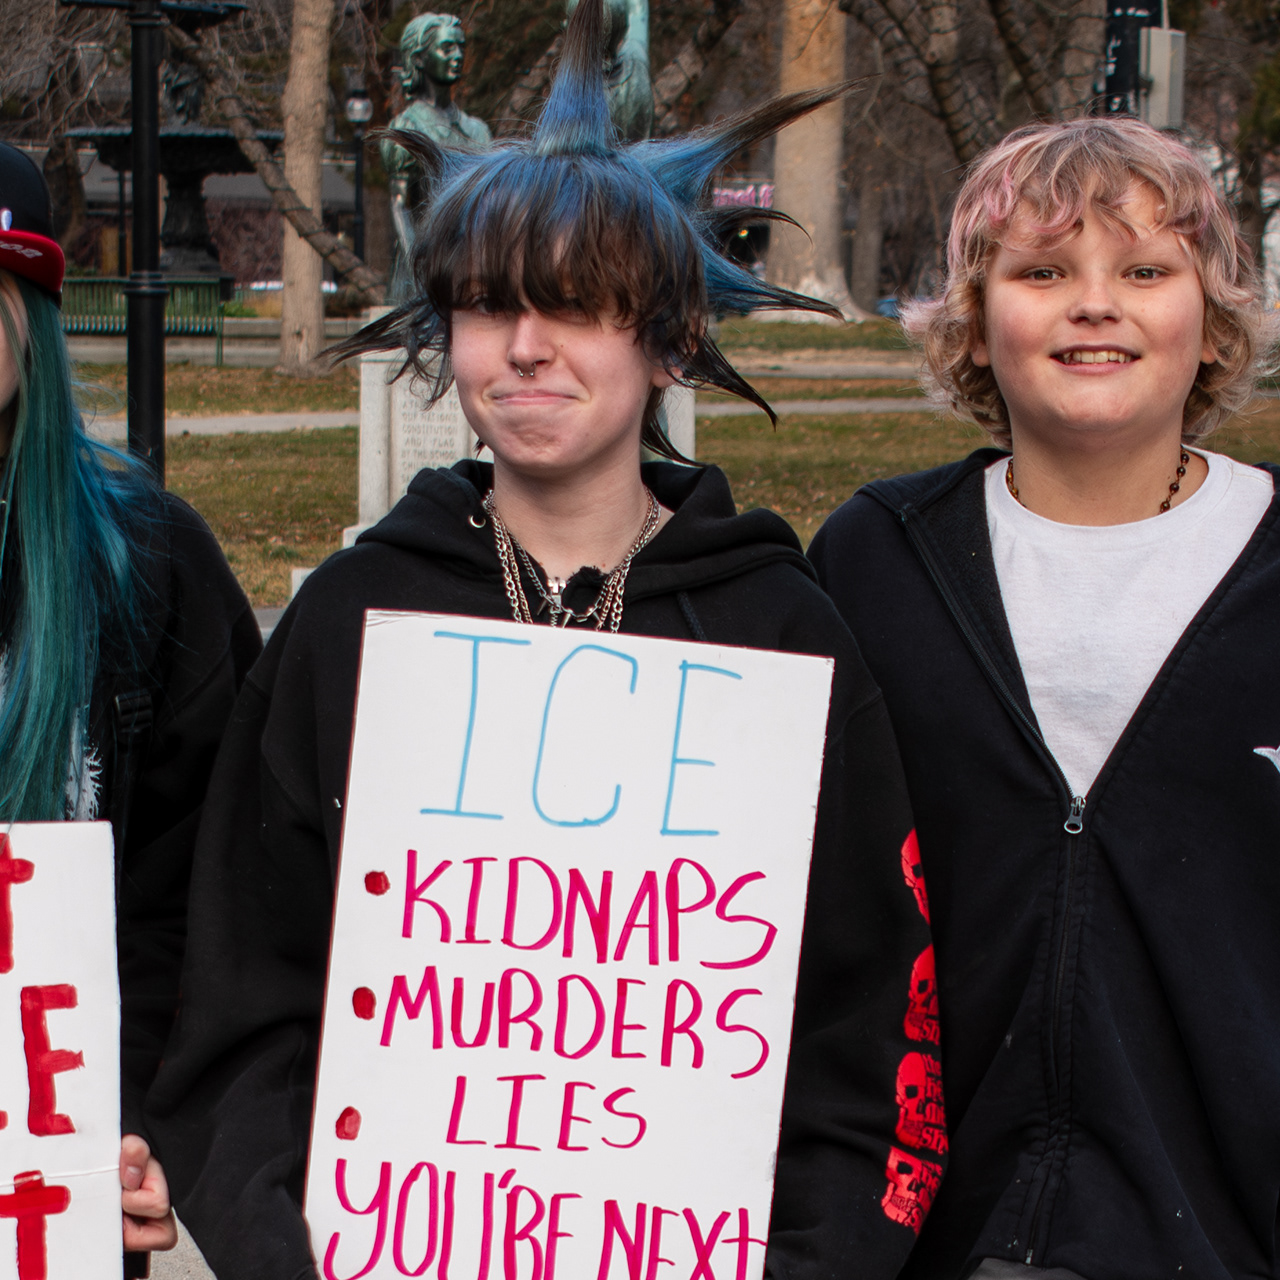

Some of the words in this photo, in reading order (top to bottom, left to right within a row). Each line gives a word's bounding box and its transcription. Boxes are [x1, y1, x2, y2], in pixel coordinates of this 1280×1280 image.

[420, 629, 743, 838] ICE
[402, 848, 779, 971] KIDNAPS
[379, 965, 770, 1080] MURDERS
[446, 1074, 647, 1152] LIES
